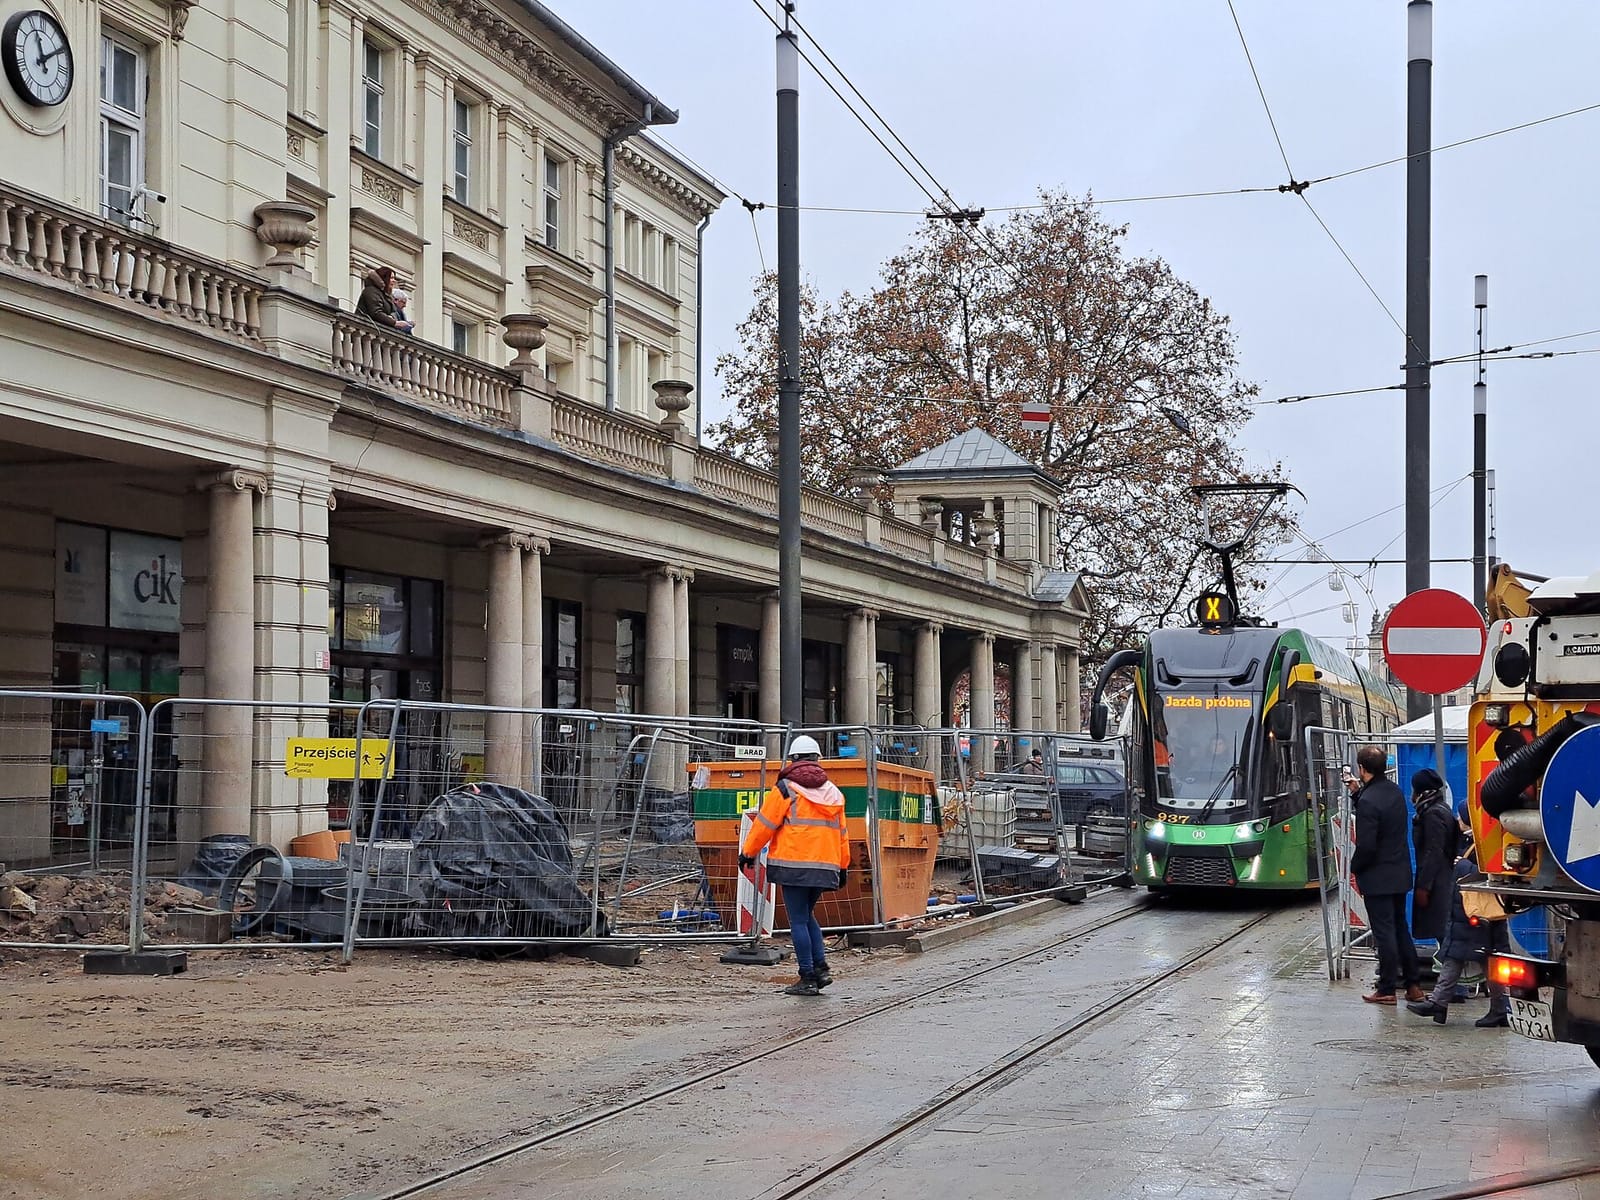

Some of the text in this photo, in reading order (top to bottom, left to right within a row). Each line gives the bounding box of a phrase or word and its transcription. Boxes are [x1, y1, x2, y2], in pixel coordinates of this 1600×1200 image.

[133, 554, 178, 605] cik
[1206, 597, 1220, 620] X
[1165, 695, 1252, 710] Jazda próbna
[294, 746, 357, 760] Przejście
[1157, 812, 1190, 825] 937
[1510, 1016, 1553, 1041] 1TX31
